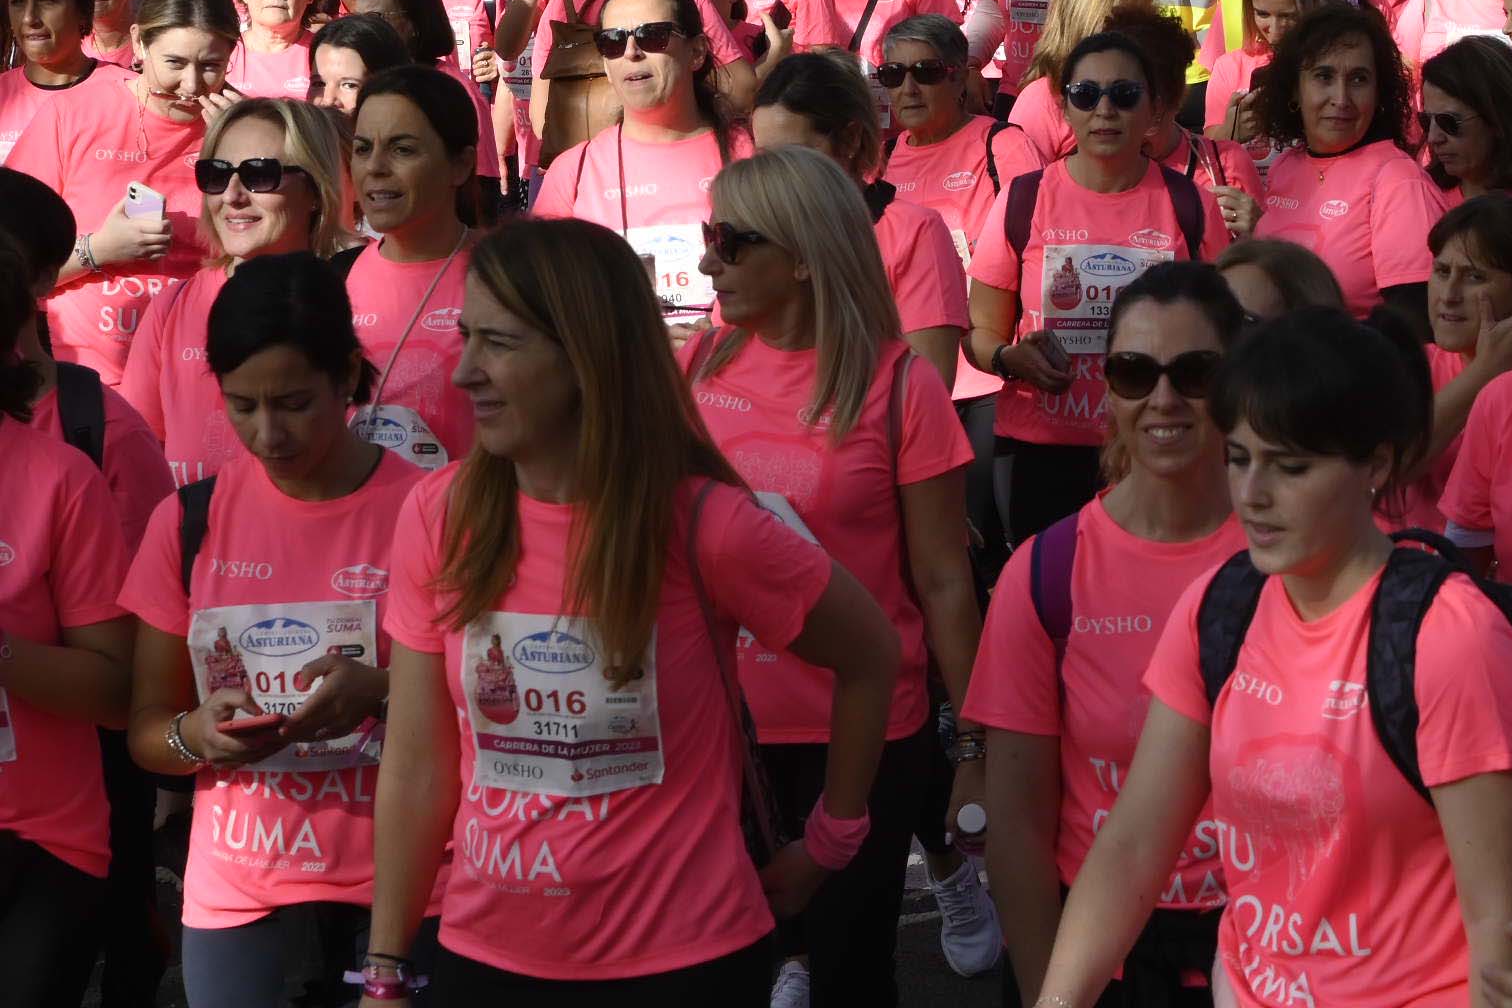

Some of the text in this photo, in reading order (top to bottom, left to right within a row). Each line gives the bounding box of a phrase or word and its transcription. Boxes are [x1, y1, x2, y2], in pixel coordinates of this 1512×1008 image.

[1011, 42, 1030, 58] SU
[95, 148, 147, 163] OYSHO
[1084, 260, 1133, 273] ASTURIANA
[656, 271, 689, 288] 16
[1086, 285, 1114, 301] 01
[98, 306, 138, 332] SU
[1090, 306, 1111, 316] 133
[1056, 320, 1090, 328] CARRERA
[696, 391, 752, 412] OYSHO
[326, 622, 362, 633] SUMA
[1074, 615, 1152, 634] OYSHO
[246, 634, 314, 648] ASTURIANA
[519, 646, 590, 664] ASTURIANA
[755, 654, 777, 664] 2023
[1233, 670, 1284, 706] SHO
[524, 688, 587, 715] 016
[534, 721, 578, 739] 31711
[494, 739, 540, 752] CARRERA
[541, 744, 555, 755] DE
[558, 746, 569, 756] LA
[570, 744, 610, 757] MUJER
[494, 760, 544, 780] OYSHO
[586, 761, 649, 781] Santander
[212, 804, 323, 858] SUMA
[464, 817, 563, 883] SUMA
[1214, 820, 1256, 871] TU
[301, 862, 327, 872] 2023
[1235, 894, 1373, 957] ORSAL
